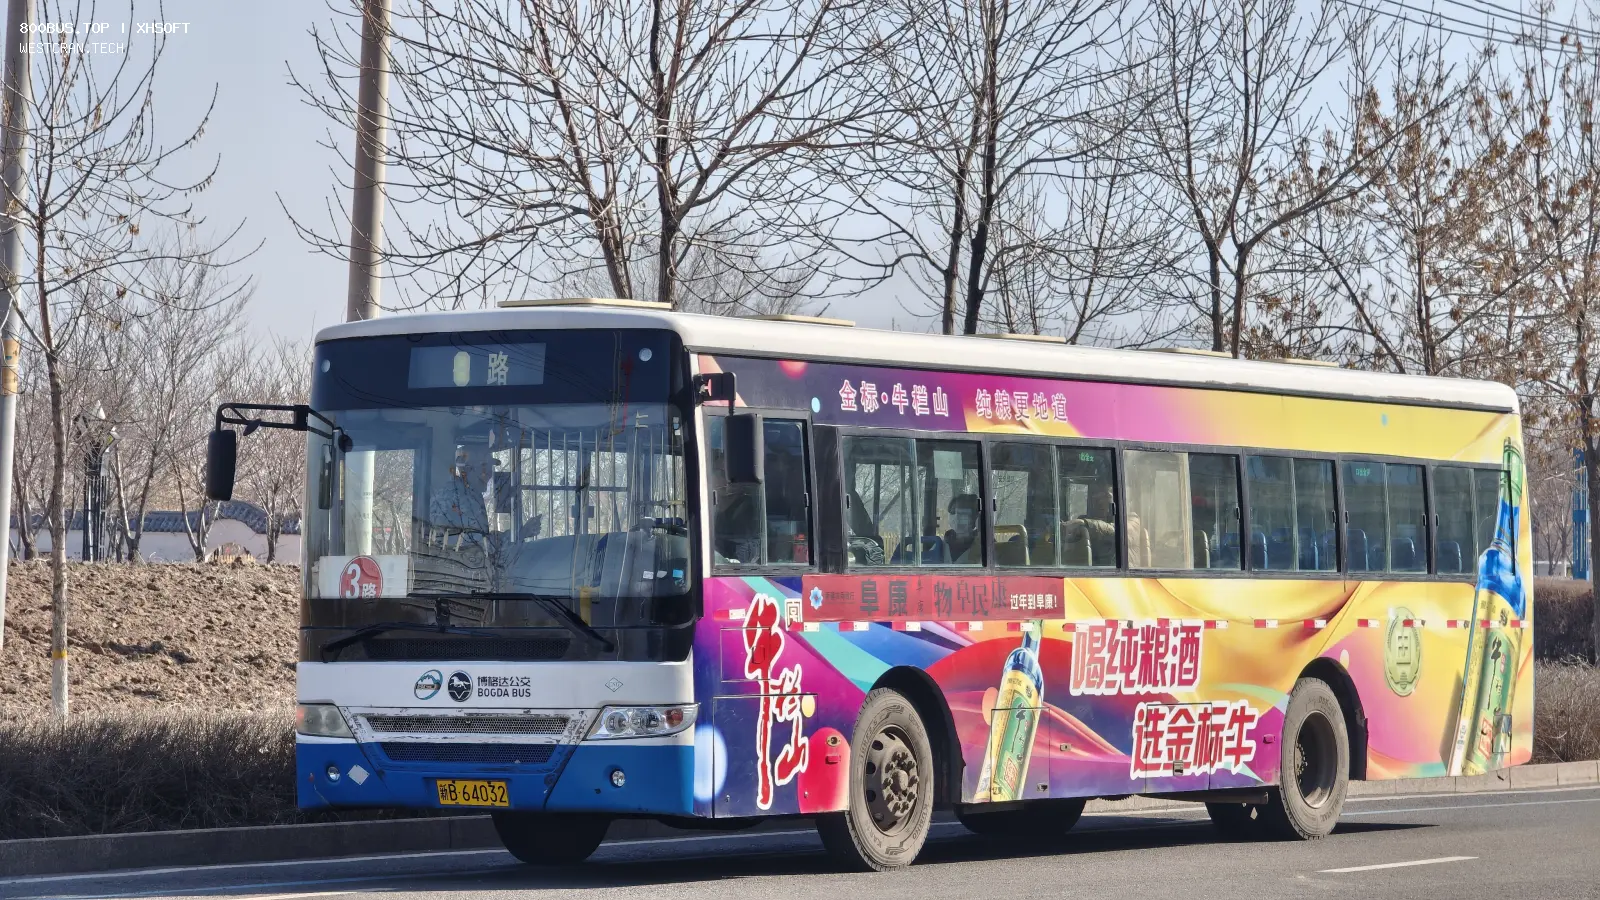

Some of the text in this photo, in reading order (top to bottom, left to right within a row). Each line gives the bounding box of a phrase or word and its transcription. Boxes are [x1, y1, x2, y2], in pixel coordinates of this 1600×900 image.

[487, 351, 509, 385] 路
[975, 388, 1069, 423] 纯粮更地道
[1010, 593, 1059, 610] 过年到阜康!
[1069, 618, 1203, 696] 喝纯粮酒
[477, 676, 531, 687] 博格达公交
[477, 688, 531, 698] BOGDA BUS
[1130, 700, 1259, 780] 选金标牛
